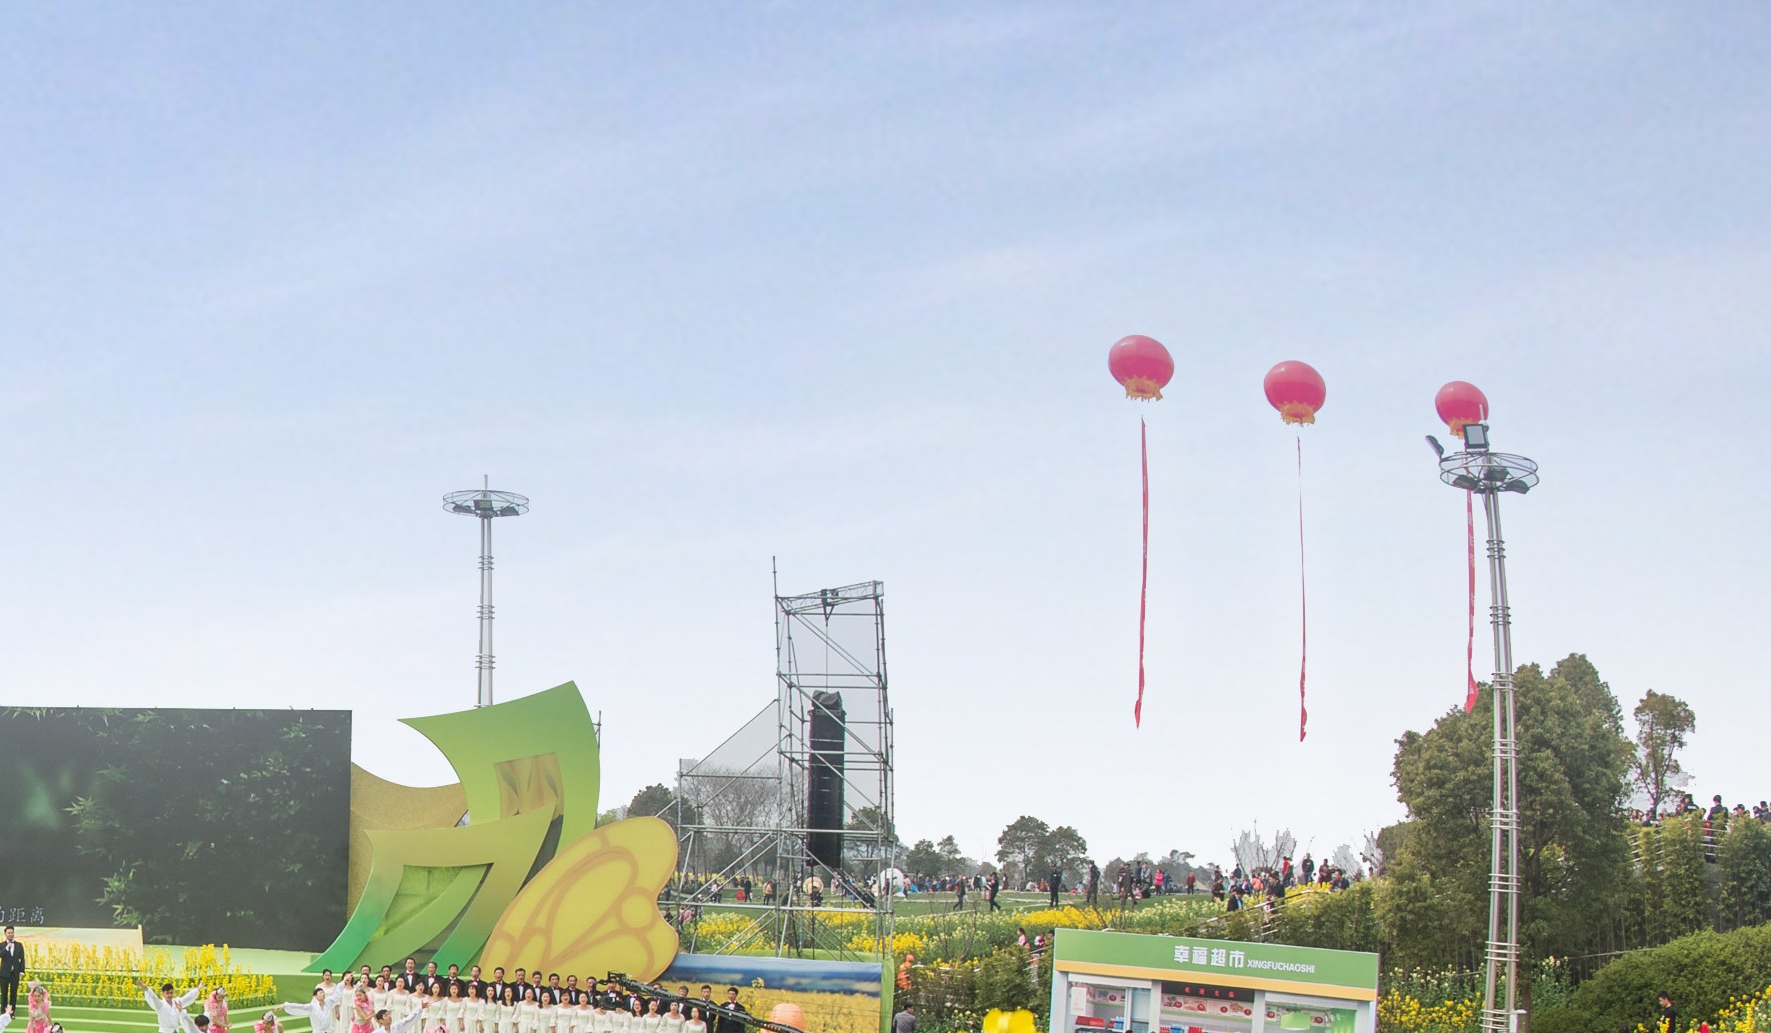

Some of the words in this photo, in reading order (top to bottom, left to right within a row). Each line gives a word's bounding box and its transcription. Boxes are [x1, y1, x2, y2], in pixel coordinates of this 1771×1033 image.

[1174, 945, 1244, 968] 幸福超市
[1247, 959, 1316, 974] XINGFUCHAOSHI
